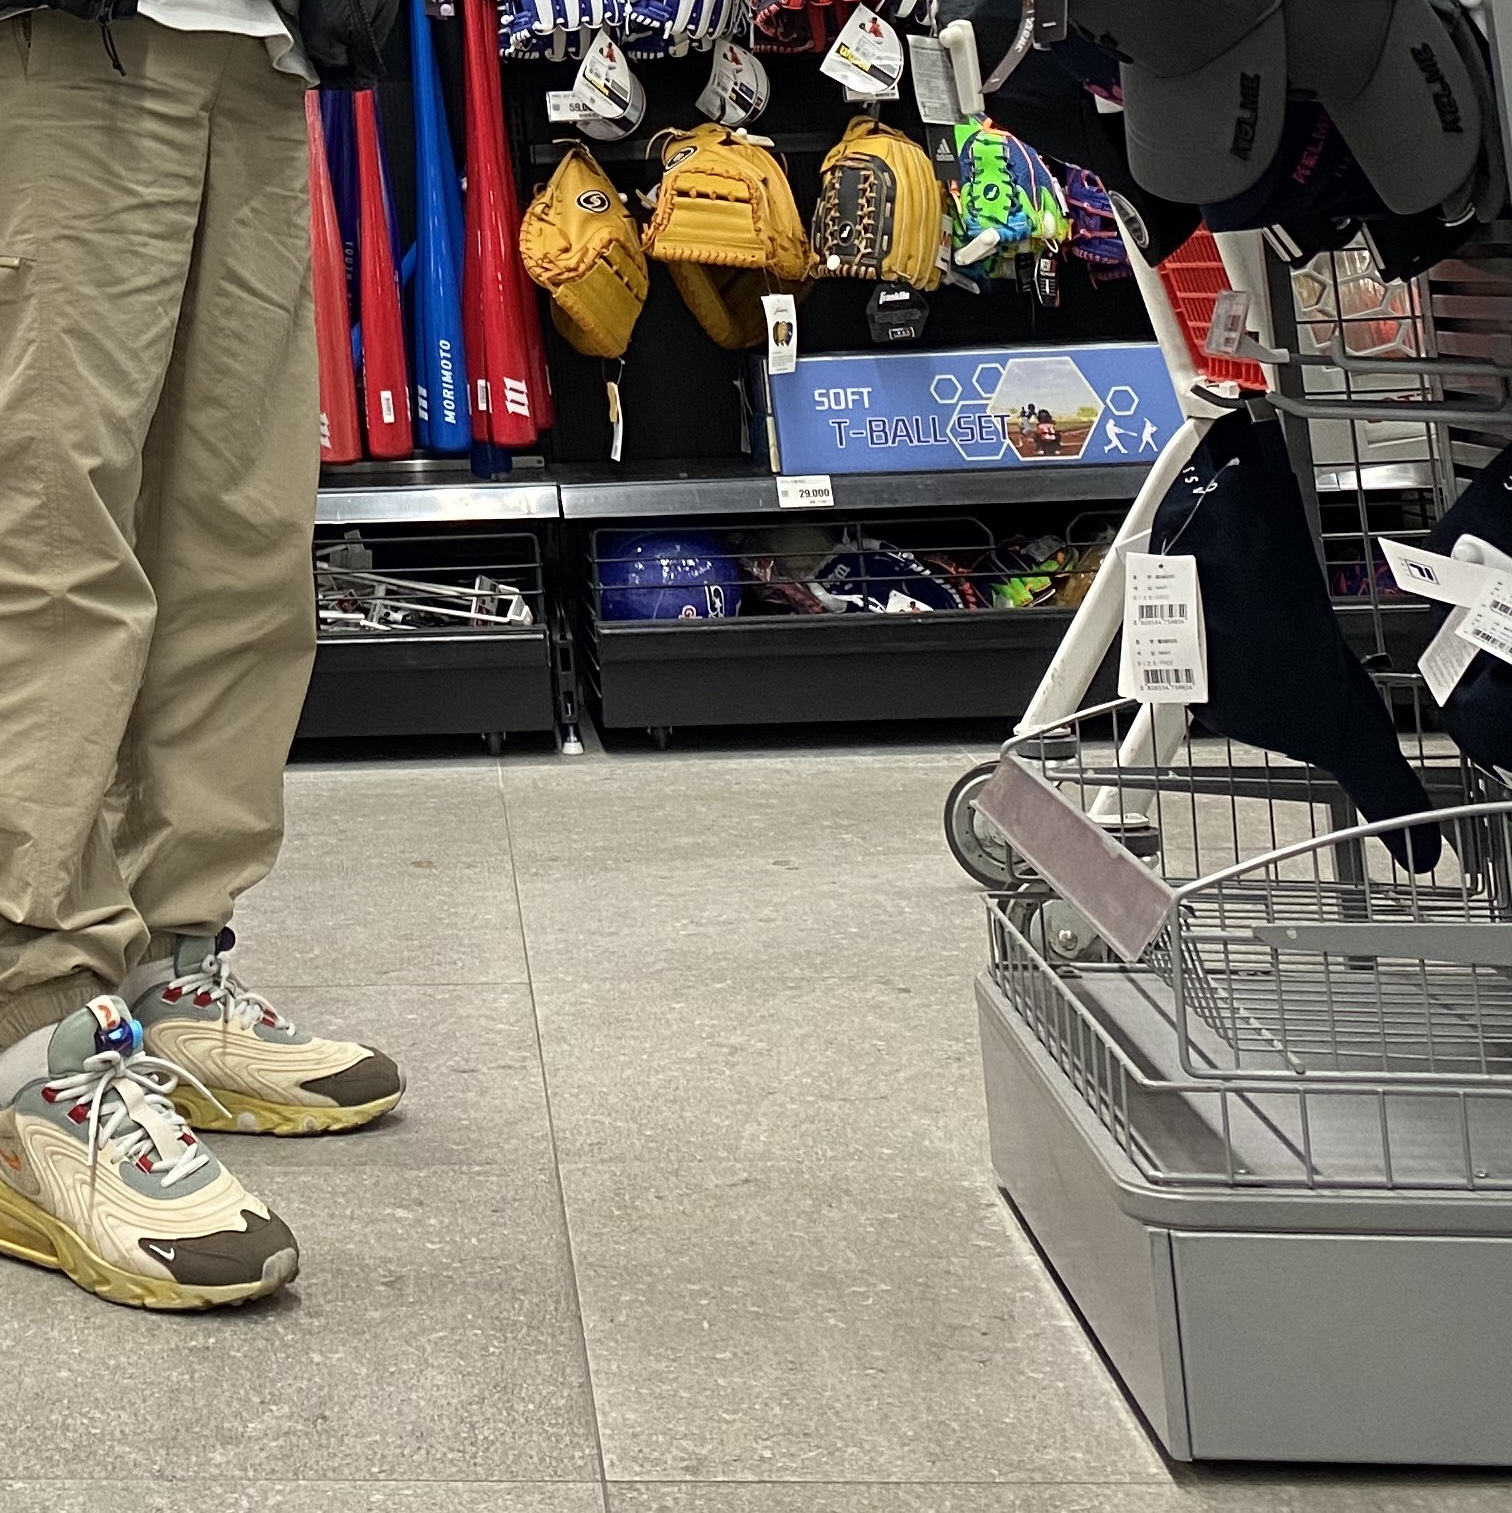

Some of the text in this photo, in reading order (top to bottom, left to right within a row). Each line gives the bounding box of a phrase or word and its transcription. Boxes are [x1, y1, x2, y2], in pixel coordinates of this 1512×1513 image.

[438, 338, 457, 425] MORIMOTO
[813, 386, 873, 411] SOFT
[829, 413, 1012, 449] T-BALL SET
